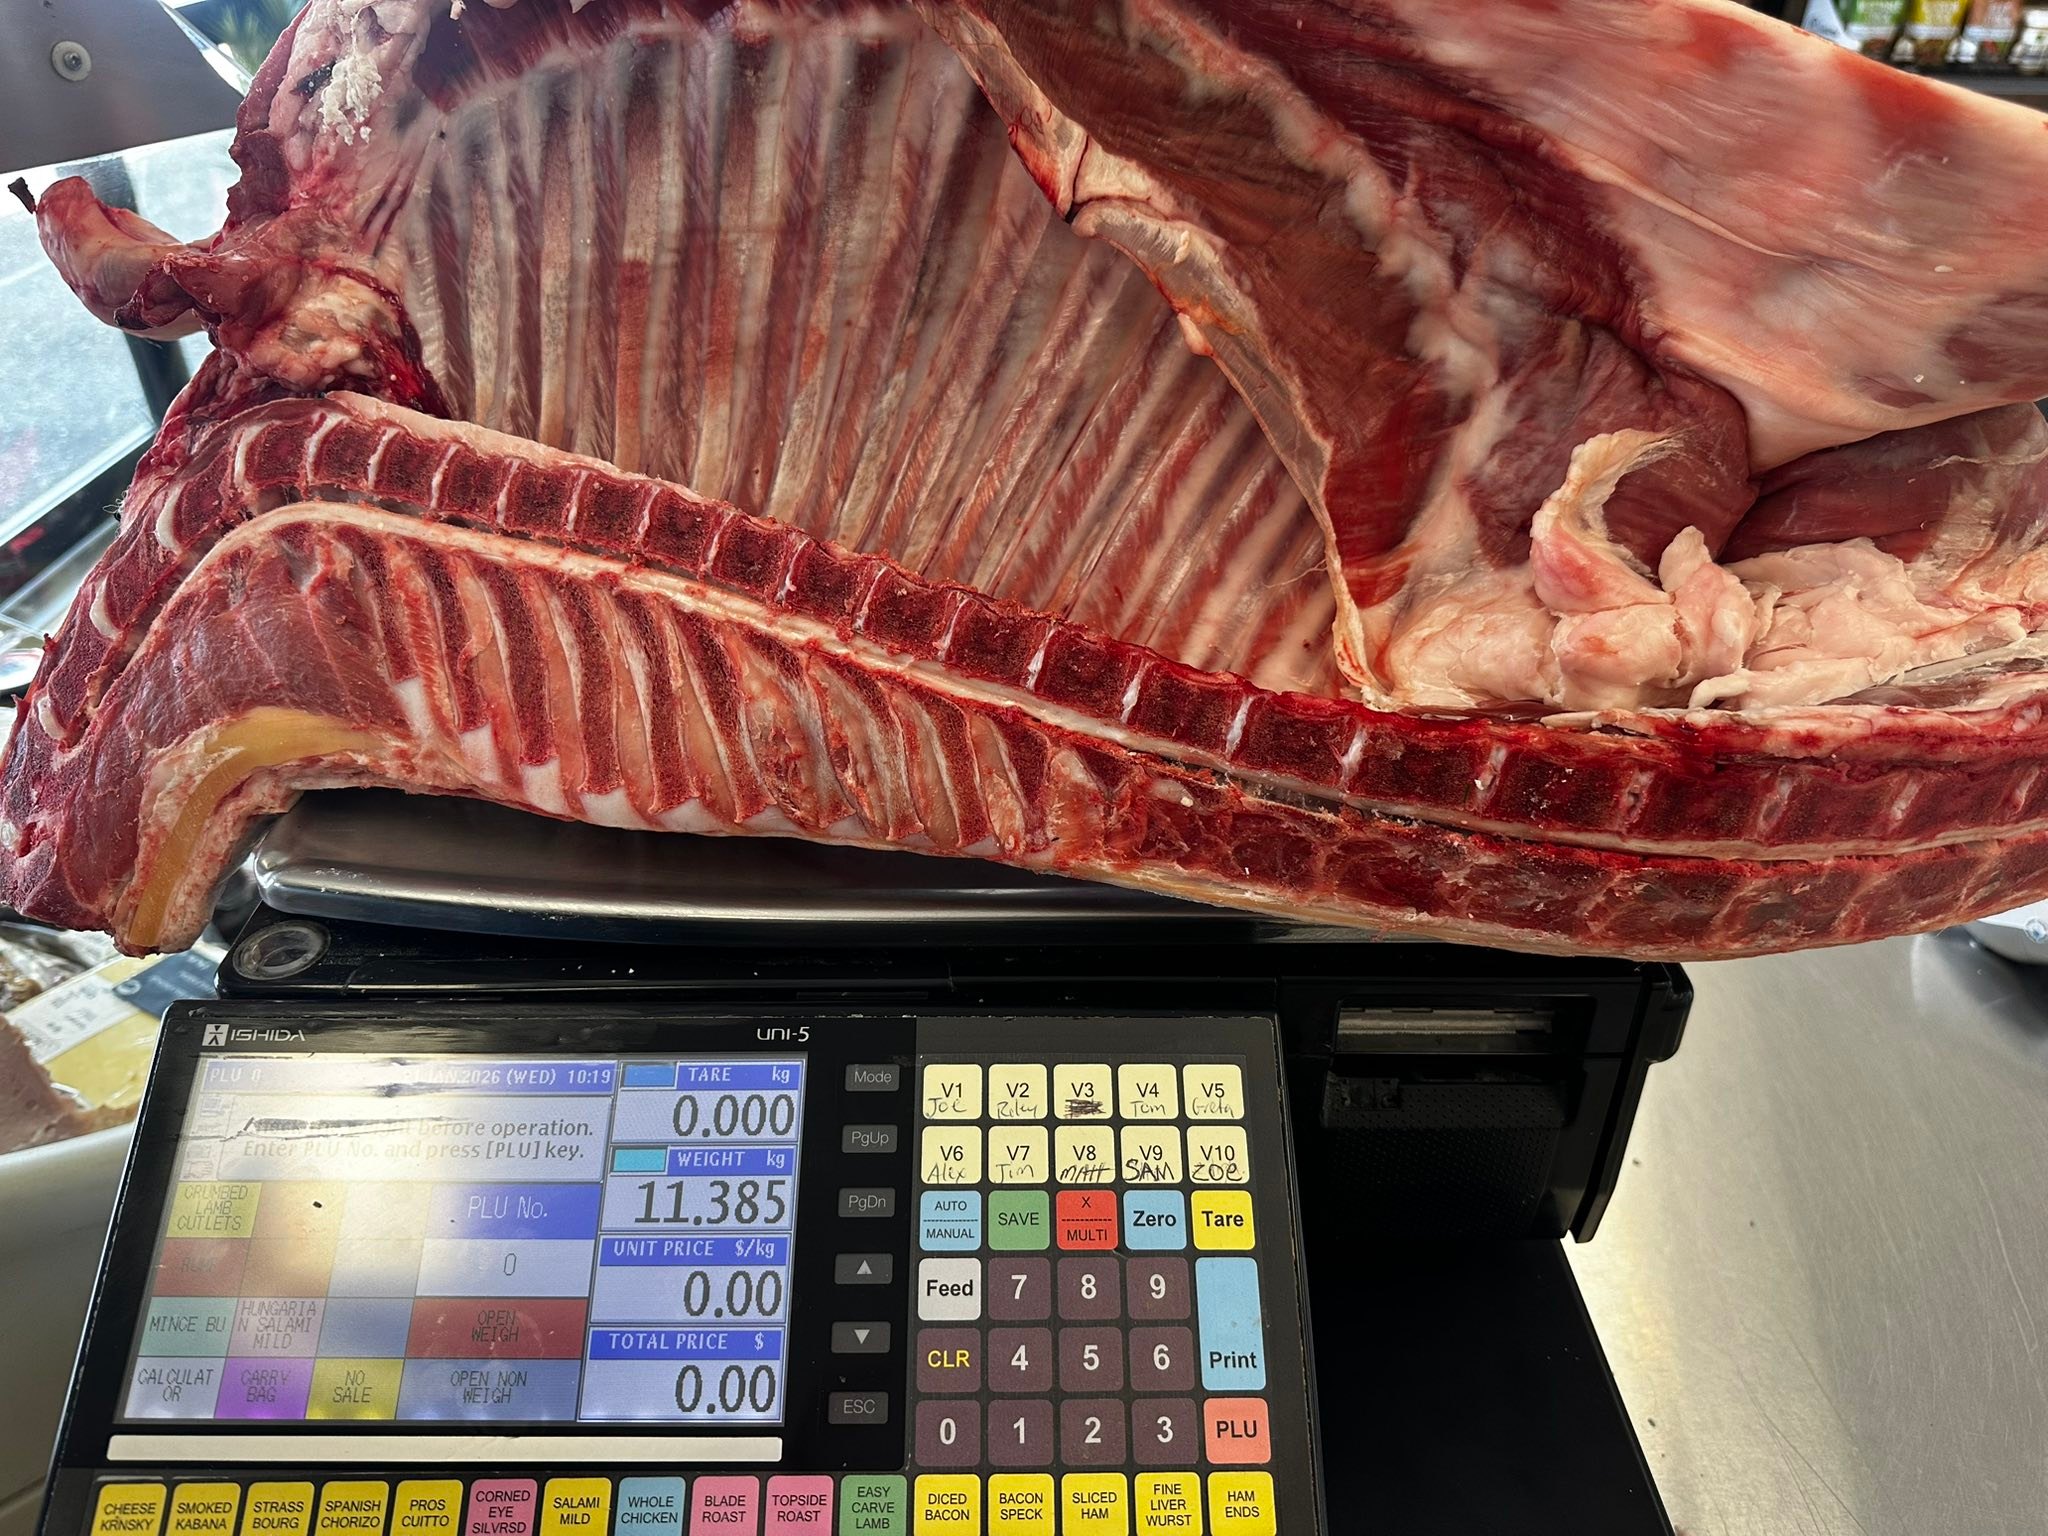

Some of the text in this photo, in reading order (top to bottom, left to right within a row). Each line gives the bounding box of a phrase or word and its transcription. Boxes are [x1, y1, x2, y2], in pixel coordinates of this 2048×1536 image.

[231, 1029, 306, 1042] ISHIDA
[756, 1027, 810, 1042] uni-5
[210, 1067, 241, 1083] PLU
[506, 1068, 557, 1085] (WED)
[568, 1069, 611, 1084] 10:19
[688, 1067, 790, 1084] TARE kg
[854, 1070, 892, 1084] Mode
[941, 1083, 962, 1098] V1
[1006, 1083, 1030, 1098] V2
[1071, 1083, 1094, 1098] V3
[1136, 1083, 1160, 1098] V4
[1201, 1083, 1225, 1098] V5
[672, 1094, 795, 1138] 0.000
[1130, 1100, 1166, 1118] Tom
[419, 1120, 485, 1136] before
[491, 1119, 593, 1138] operation.
[852, 1131, 889, 1147] PgUp
[243, 1140, 584, 1160] Enter PLU No. and press [PLU] key.
[941, 1146, 963, 1161] V6
[1006, 1146, 1030, 1161] V7
[1073, 1146, 1096, 1161] V8
[1139, 1146, 1163, 1161] V9
[1200, 1146, 1235, 1161] V10
[677, 1152, 785, 1169] WEIGHT kg
[995, 1163, 1034, 1183] Jim
[184, 1185, 248, 1200] CRUMBED
[195, 1200, 233, 1215] LAMB
[467, 1197, 548, 1220] PLU No.
[634, 1179, 787, 1226] 11.385
[848, 1195, 886, 1211] PgDn
[934, 1200, 967, 1212] AUTO
[176, 1215, 241, 1231] CUTLETS
[998, 1212, 1040, 1226] SAVE
[1133, 1211, 1177, 1227] Zero
[1201, 1211, 1244, 1227] Tare
[926, 1229, 975, 1240] MANUAL
[1067, 1229, 1108, 1241] MULTI
[613, 1239, 775, 1258] UNIT PRICE $/kg
[503, 1253, 518, 1276] 0
[683, 1270, 782, 1318] 0.00
[926, 1280, 974, 1296] Feed
[1011, 1274, 1027, 1299] 7
[1081, 1274, 1096, 1299] 8
[1150, 1274, 1166, 1299] 9
[241, 1301, 316, 1317] HUNGARIA
[150, 1316, 226, 1332] MINCE BU
[238, 1317, 312, 1333] N SALAMI
[478, 1311, 517, 1326] OPEN
[253, 1333, 292, 1349] MILD
[471, 1327, 519, 1343] WEIGH
[609, 1332, 765, 1350] TOTAL PRICE $
[928, 1351, 970, 1368] CLR
[1011, 1345, 1028, 1371] 4
[1083, 1345, 1100, 1370] 5
[1153, 1344, 1170, 1370] 6
[1210, 1351, 1257, 1368] Print
[137, 1370, 213, 1386] CALCULAT
[240, 1370, 290, 1386] CARRY
[346, 1370, 366, 1386] NO
[450, 1371, 527, 1387] OPEN NON
[161, 1386, 182, 1402] OR
[246, 1387, 276, 1403] BAG
[332, 1387, 372, 1403] SALE
[462, 1388, 512, 1404] WEIGH
[675, 1364, 776, 1414] 0.00
[843, 1399, 876, 1414] ESC
[940, 1418, 956, 1444] 0
[1013, 1418, 1025, 1444] 1
[1084, 1417, 1101, 1443] 2
[1157, 1416, 1173, 1442] 3
[1217, 1420, 1257, 1438] PLU
[475, 1490, 531, 1503] CORNED
[857, 1486, 891, 1498] EASY
[1154, 1483, 1182, 1495] FINE
[1227, 1490, 1255, 1502] HAM
[553, 1497, 600, 1509] SALAMI
[628, 1496, 674, 1508] WHOLE
[704, 1495, 746, 1508] BLADE
[772, 1494, 827, 1507] TOPSIDE
[928, 1493, 967, 1505] DICED
[1000, 1492, 1043, 1504] BACON
[1072, 1491, 1117, 1503] SLICED
[104, 1503, 157, 1515] CHEESE
[176, 1502, 232, 1514] SMOKED
[253, 1501, 304, 1513] STRASS
[325, 1500, 381, 1512] SPANISH
[409, 1500, 446, 1511] PROS
[488, 1506, 514, 1519] EYE
[852, 1502, 894, 1514] CARVE
[1151, 1499, 1187, 1511] LIVER
[1225, 1506, 1260, 1518] ENDS
[559, 1513, 590, 1525] MILD
[621, 1512, 678, 1524] CHICKEN
[702, 1511, 746, 1523] ROAST
[777, 1510, 820, 1522] ROAST
[925, 1509, 970, 1521] BACON
[1000, 1508, 1043, 1520] SPECK
[1082, 1507, 1109, 1519] HAM
[1146, 1514, 1192, 1526] WURST
[175, 1518, 227, 1529] KABANA
[252, 1517, 299, 1529] BOURG
[321, 1516, 380, 1528] CHORIZO
[401, 1515, 449, 1527] CUITTO
[472, 1521, 527, 1534] SILVRSD
[856, 1517, 890, 1529] LAMB
